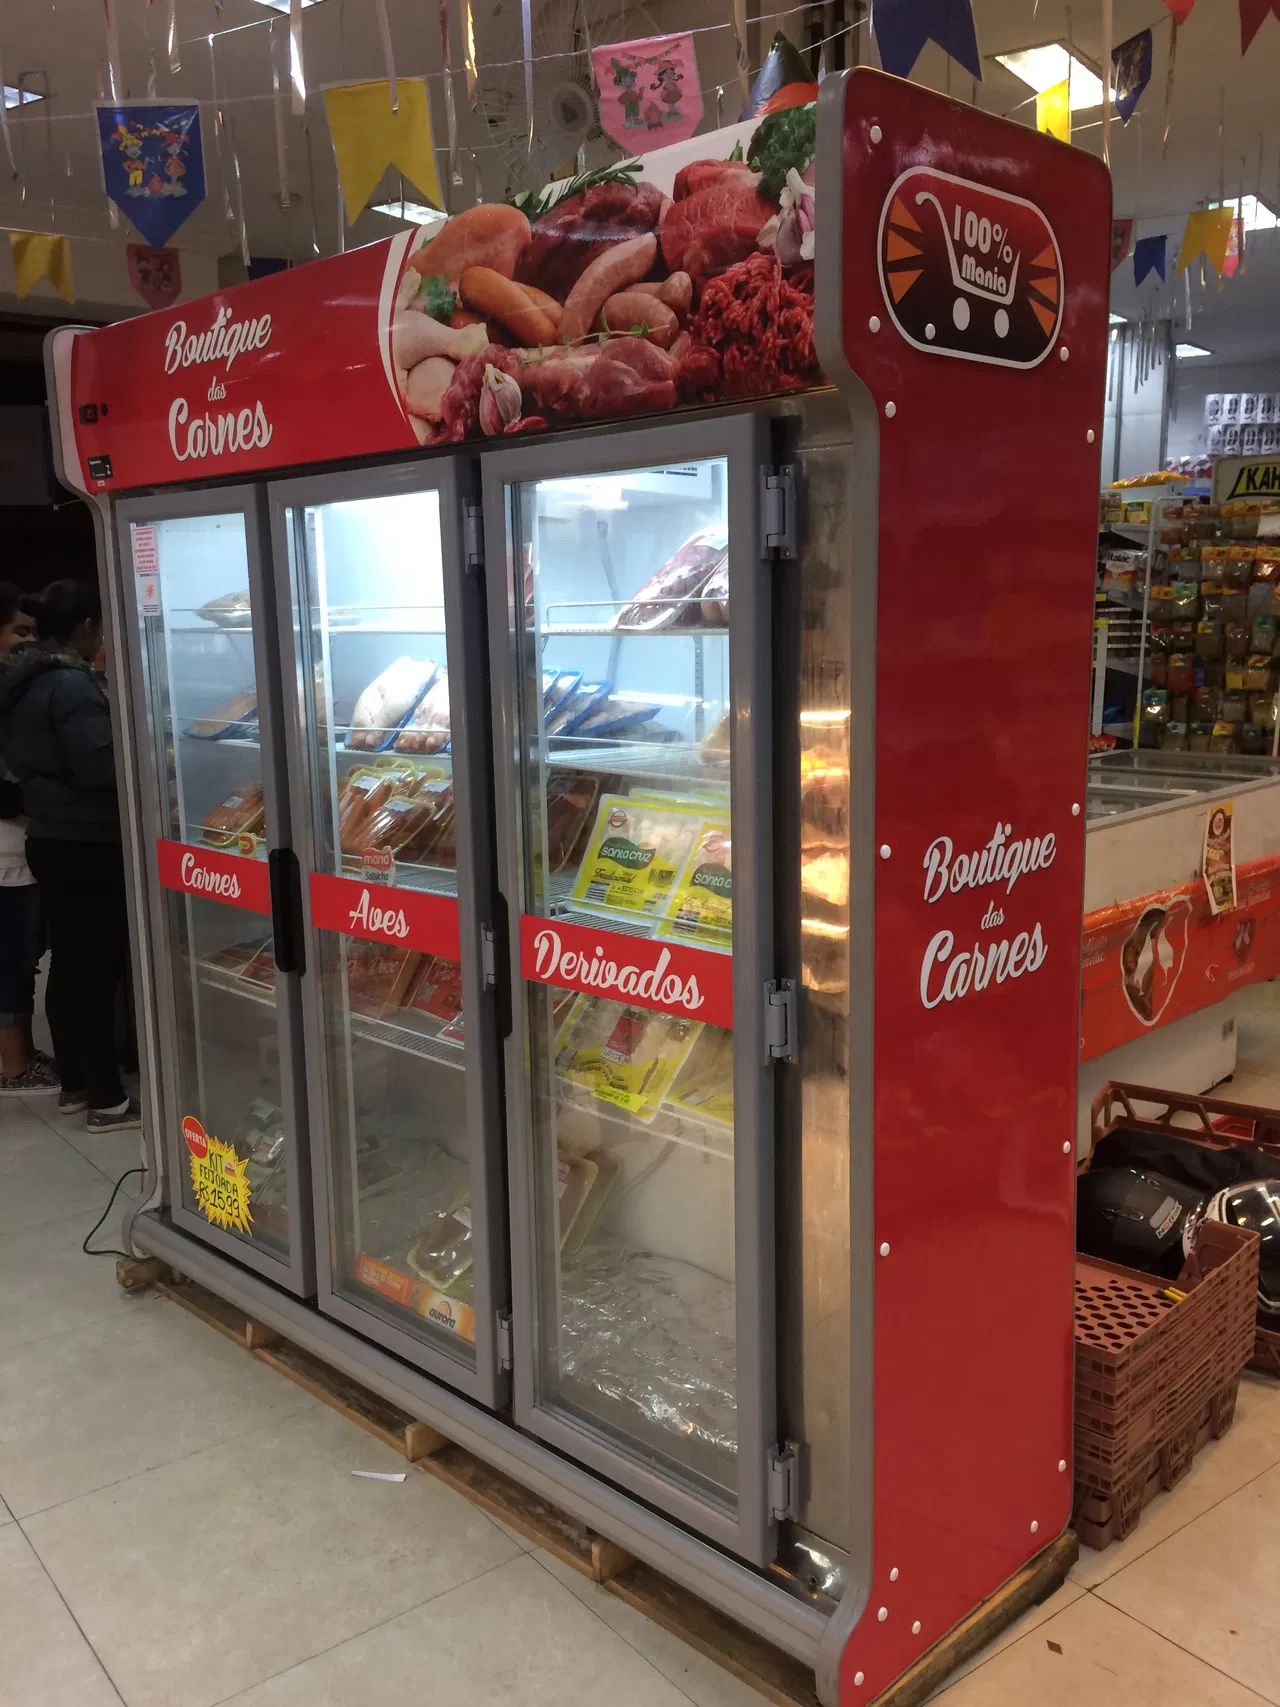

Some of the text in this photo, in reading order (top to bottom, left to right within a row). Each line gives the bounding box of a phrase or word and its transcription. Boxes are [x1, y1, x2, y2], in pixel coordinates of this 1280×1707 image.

[953, 204, 1013, 264] 100%
[164, 306, 272, 375] Boutique
[207, 375, 228, 402] das
[168, 397, 273, 462] Carnes
[181, 852, 242, 899] Carnes
[923, 821, 1056, 904] Boutique
[349, 888, 410, 938] Aves
[981, 900, 1005, 930] das
[533, 929, 705, 1010] Derivados
[920, 922, 1048, 1009] Carnes
[185, 1128, 207, 1149] OFERTA
[208, 1149, 223, 1174] KIT
[199, 1164, 239, 1199] FEIJOADA
[428, 1308, 457, 1329] aurora
